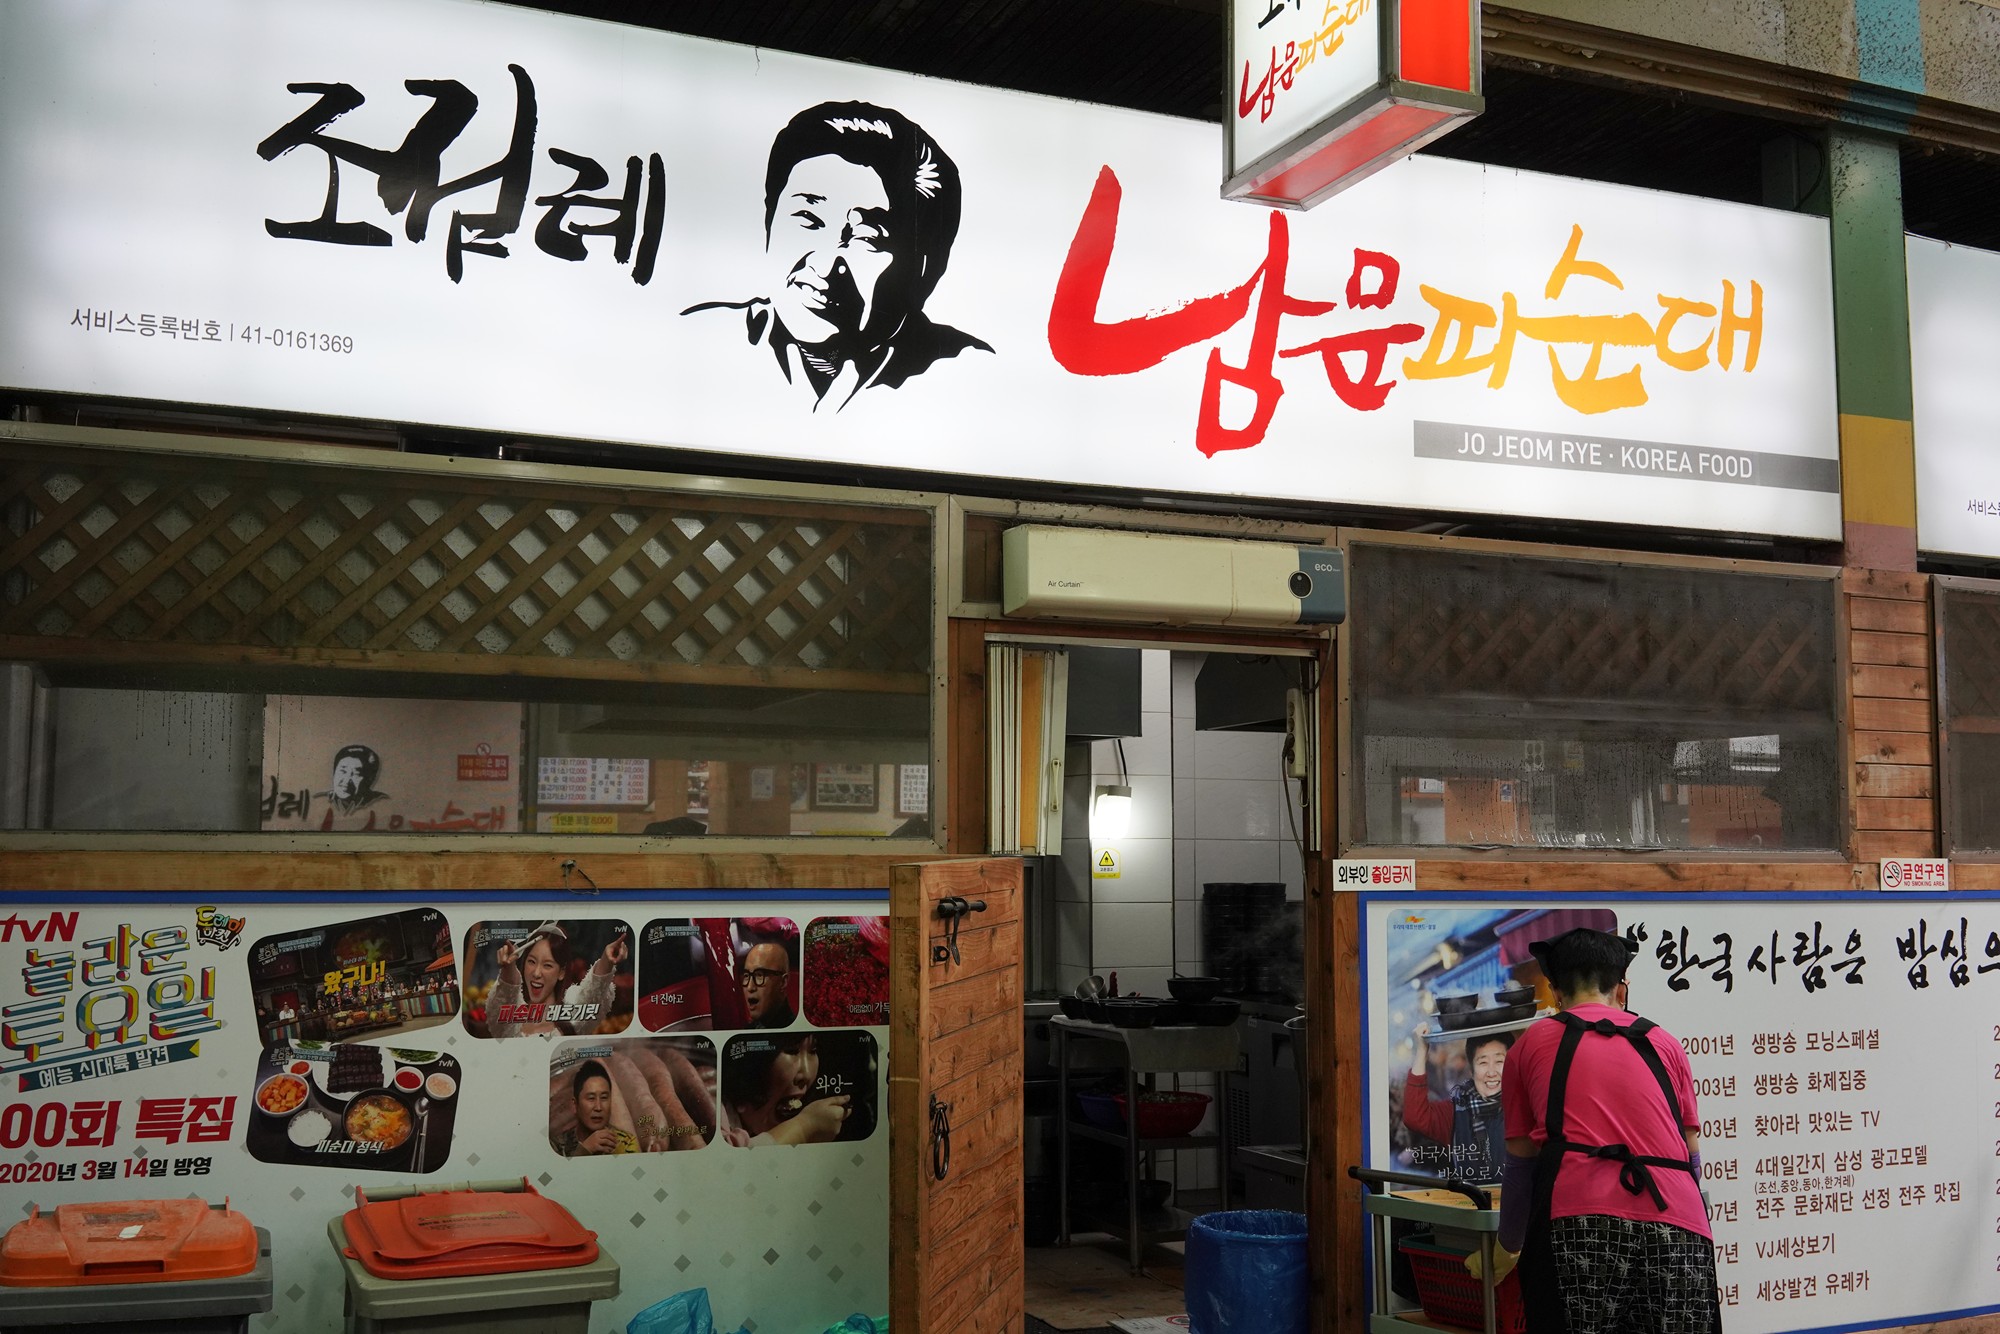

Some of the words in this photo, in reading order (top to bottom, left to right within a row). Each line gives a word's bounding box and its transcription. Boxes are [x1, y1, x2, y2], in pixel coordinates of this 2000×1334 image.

[256, 63, 667, 286] 조점례
[70, 308, 222, 344] 서비스등록번호
[240, 325, 355, 356] 41-0161369
[1457, 431, 1486, 455] JO
[1492, 434, 1554, 462] JEOM
[1561, 441, 1602, 466] RYE
[1621, 446, 1693, 474] KOREA
[1699, 453, 1753, 479] FOOD
[1967, 499, 2000, 516] 서비스
[1314, 563, 1333, 572] eco
[1338, 865, 1369, 885] 외부인
[1371, 864, 1412, 885] 출입금지
[1902, 863, 1945, 881] 금연구역
[0, 911, 80, 943] tvN
[195, 905, 246, 934] 도레미
[421, 912, 438, 922] tvN
[614, 925, 628, 933] tvN
[202, 926, 232, 943] 마켓
[22, 923, 191, 998] 놀라운
[1747, 920, 1867, 993] 사람은
[323, 959, 387, 996] 왔구나!
[498, 1003, 545, 1023] 피순대
[545, 1002, 600, 1022] 레츠기릿
[650, 994, 660, 1004] 더
[660, 993, 685, 1006] 진하고
[1681, 1033, 1735, 1056] 2001년
[1751, 1032, 1797, 1055] 생방송
[1805, 1028, 1880, 1051] 모닝스페셜
[38, 1066, 74, 1088] 예능
[79, 1053, 131, 1081] 신대륙
[136, 1044, 170, 1068] 발견
[438, 1059, 454, 1068] tvN
[1753, 1072, 1800, 1096] 생방송
[1807, 1069, 1868, 1092] 화제집중
[135, 1095, 238, 1146] 특집
[1754, 1113, 1800, 1137] 찾아라
[1808, 1110, 1853, 1133] 맛있는
[1861, 1110, 1881, 1128] TV
[314, 1138, 356, 1154] 피순대
[356, 1140, 385, 1155] 정식
[1755, 1152, 1826, 1177] 4대일간지
[1833, 1149, 1863, 1172] 삼성
[1870, 1144, 1928, 1170] 광고모델
[0, 1162, 78, 1184] 2020년
[81, 1159, 118, 1181] 3월
[123, 1157, 169, 1179] 14일
[174, 1156, 213, 1177] 방영
[1754, 1174, 1855, 1195] (조선,중앙,동아,한겨레)
[1755, 1197, 1786, 1220] 전주
[1793, 1190, 1854, 1216] 문화재단
[1861, 1187, 1891, 1211] 선정
[1897, 1184, 1927, 1207] 전주
[1933, 1180, 1962, 1203] 맛집
[1755, 1232, 1837, 1260] VJ세상보기
[1756, 1275, 1818, 1303] 세상발견
[1825, 1269, 1871, 1296] 유레카
